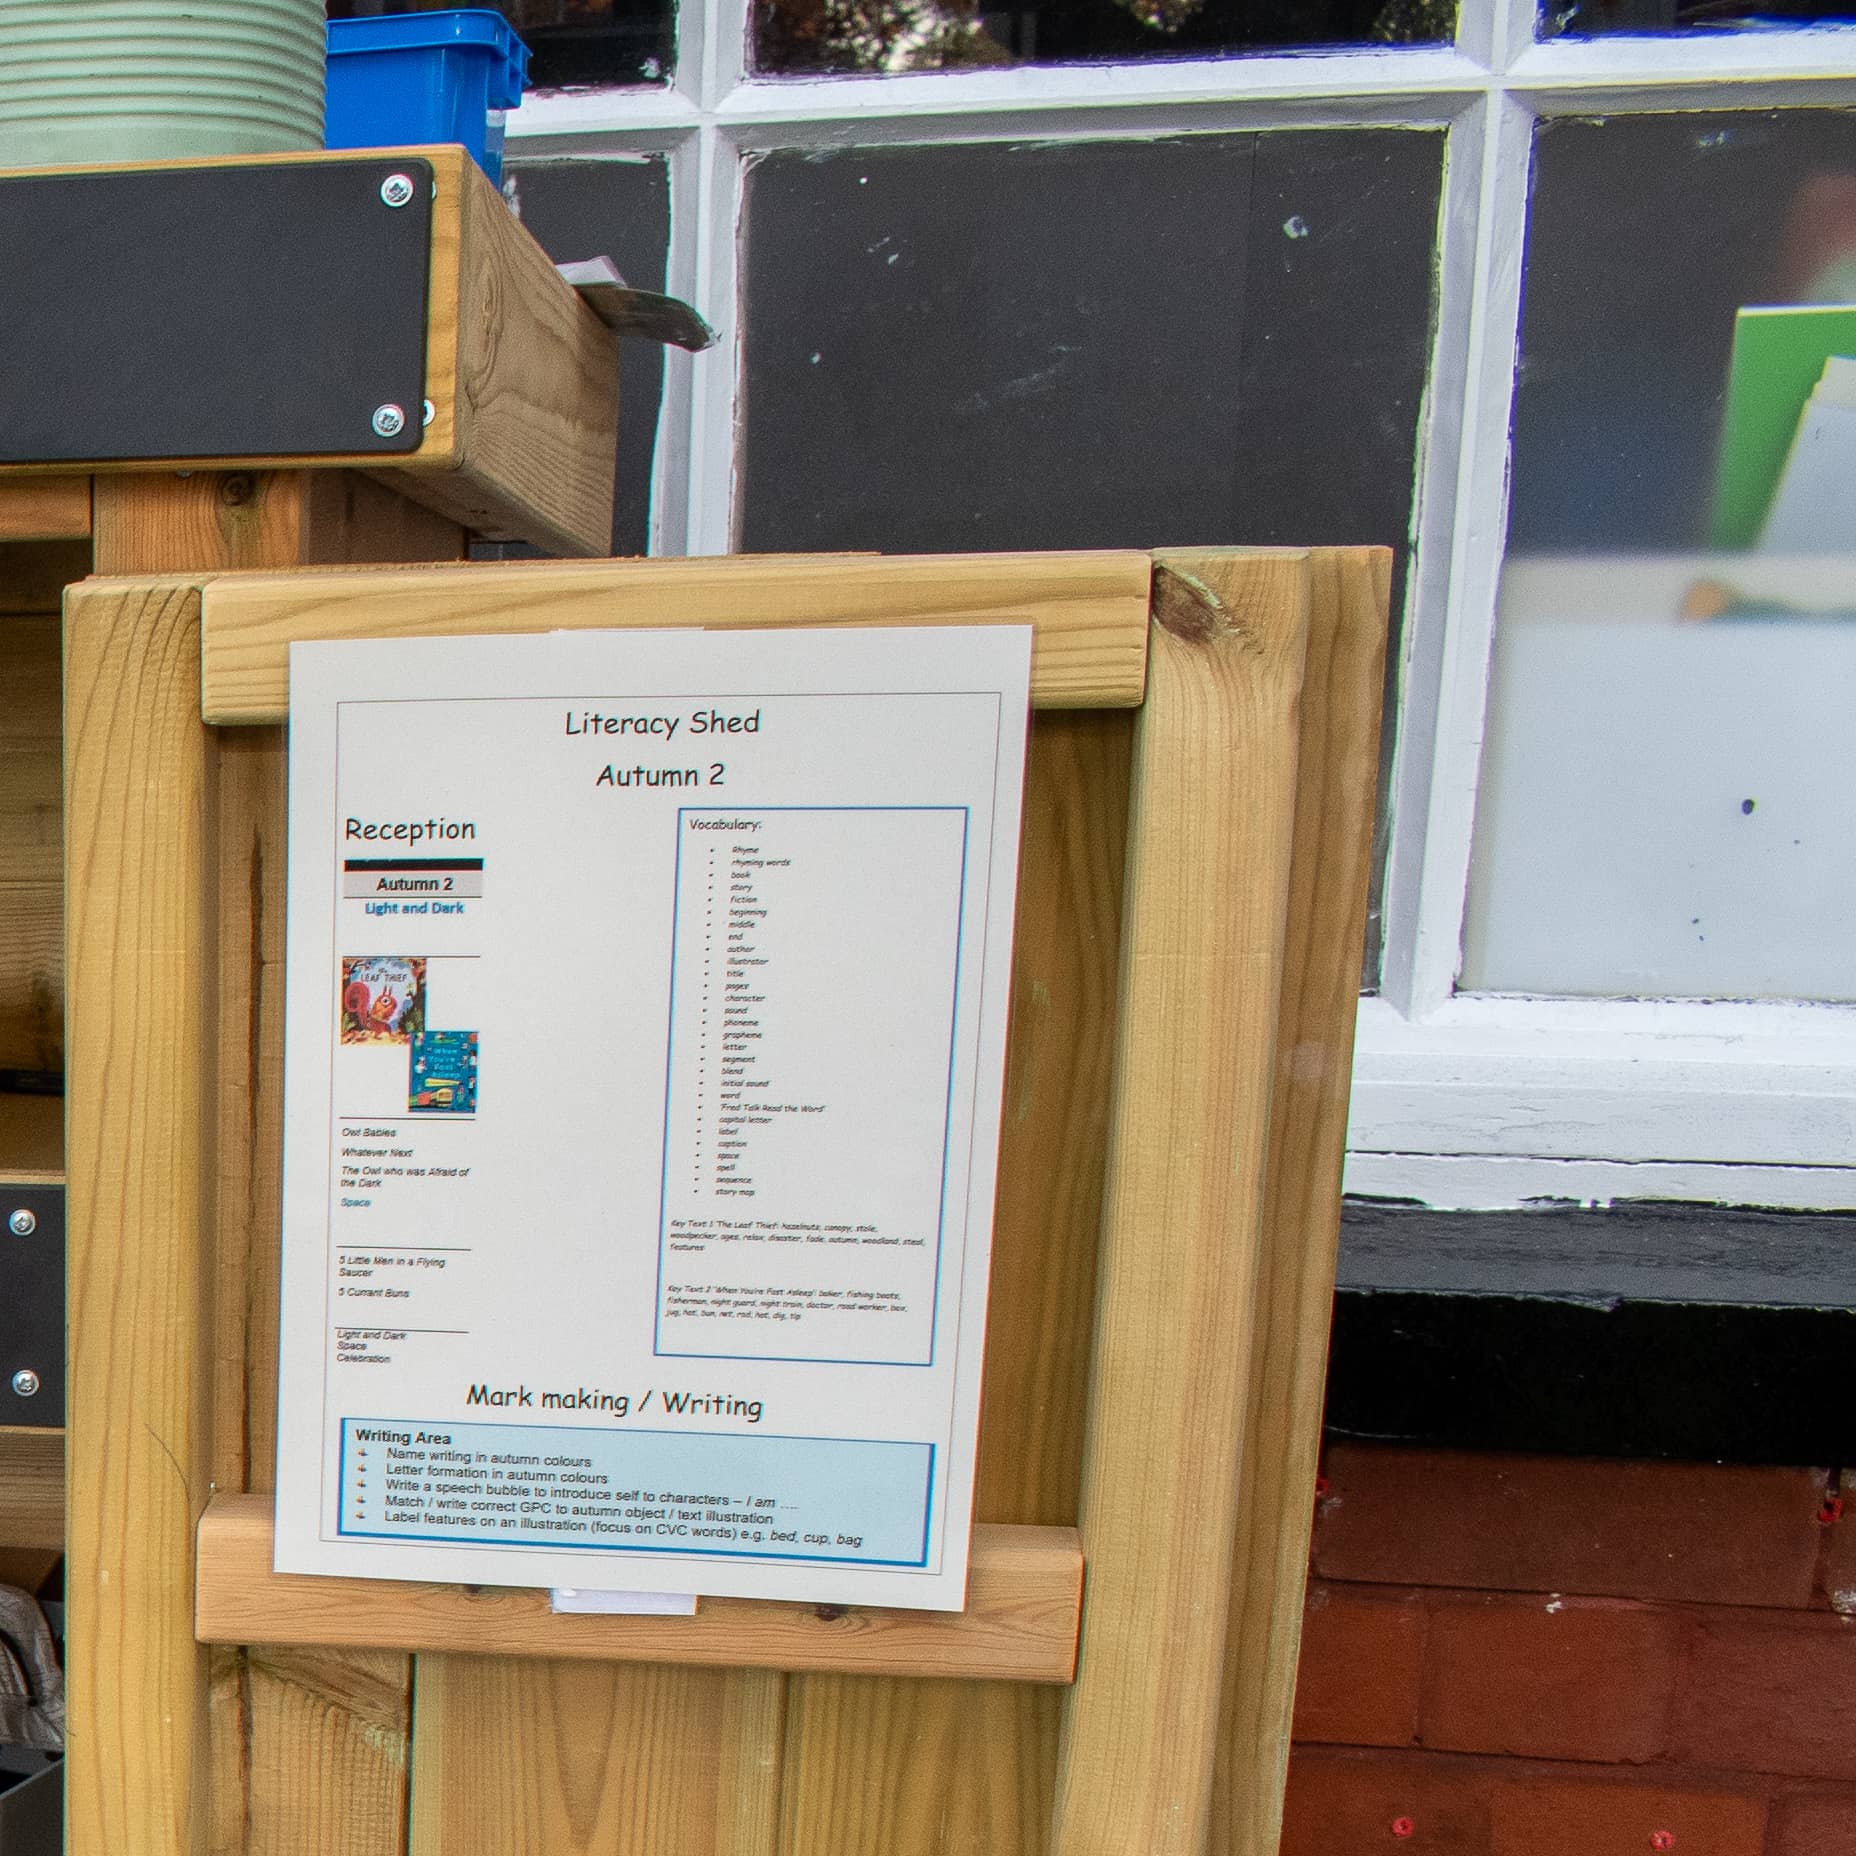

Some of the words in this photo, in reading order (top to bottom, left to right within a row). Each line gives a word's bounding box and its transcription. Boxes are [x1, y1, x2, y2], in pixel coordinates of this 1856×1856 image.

[565, 712, 679, 739] Literacy
[689, 709, 761, 733] Shed
[596, 765, 699, 786] Autumn
[709, 762, 725, 785] 2
[344, 815, 476, 854] Reception
[689, 818, 761, 831] Vocabulary:
[376, 877, 440, 890] Autumn
[442, 877, 453, 890] 2
[365, 901, 399, 916] Light
[401, 901, 429, 913] and
[431, 901, 464, 913] Dark
[465, 1384, 533, 1406] Mark
[541, 1388, 630, 1417] making
[662, 1392, 764, 1422] Writing
[355, 1429, 412, 1445] Writing
[414, 1431, 452, 1444] Area
[386, 1447, 425, 1460] Name
[429, 1450, 473, 1464] writing
[475, 1451, 487, 1462] in
[490, 1454, 539, 1464] autumn
[543, 1456, 592, 1467] colours
[386, 1463, 424, 1475] Letter
[427, 1465, 489, 1478] formation
[492, 1468, 503, 1479] in
[506, 1471, 557, 1481] autumn
[560, 1472, 609, 1483] colours
[386, 1479, 421, 1490] Write
[435, 1483, 483, 1494] speech
[486, 1484, 531, 1496] bubble
[534, 1487, 547, 1497] to
[550, 1487, 613, 1499] introduce
[615, 1490, 640, 1501] self
[642, 1491, 656, 1502] to
[658, 1492, 729, 1505] characters
[754, 1497, 777, 1507] am
[385, 1495, 425, 1506] Match
[436, 1498, 467, 1509] write
[470, 1501, 517, 1512] correct
[519, 1501, 551, 1513] GPC
[555, 1503, 569, 1514] to
[571, 1506, 622, 1516] autumn
[624, 1506, 667, 1520] object
[677, 1509, 703, 1520] text
[705, 1510, 774, 1524] illustration
[384, 1511, 421, 1522] Label
[423, 1512, 477, 1525] features
[480, 1517, 497, 1526] on
[500, 1518, 517, 1527] an
[520, 1517, 587, 1530] illustration
[634, 1525, 653, 1534] on
[656, 1523, 687, 1535] CVC
[836, 1533, 863, 1548] bag
